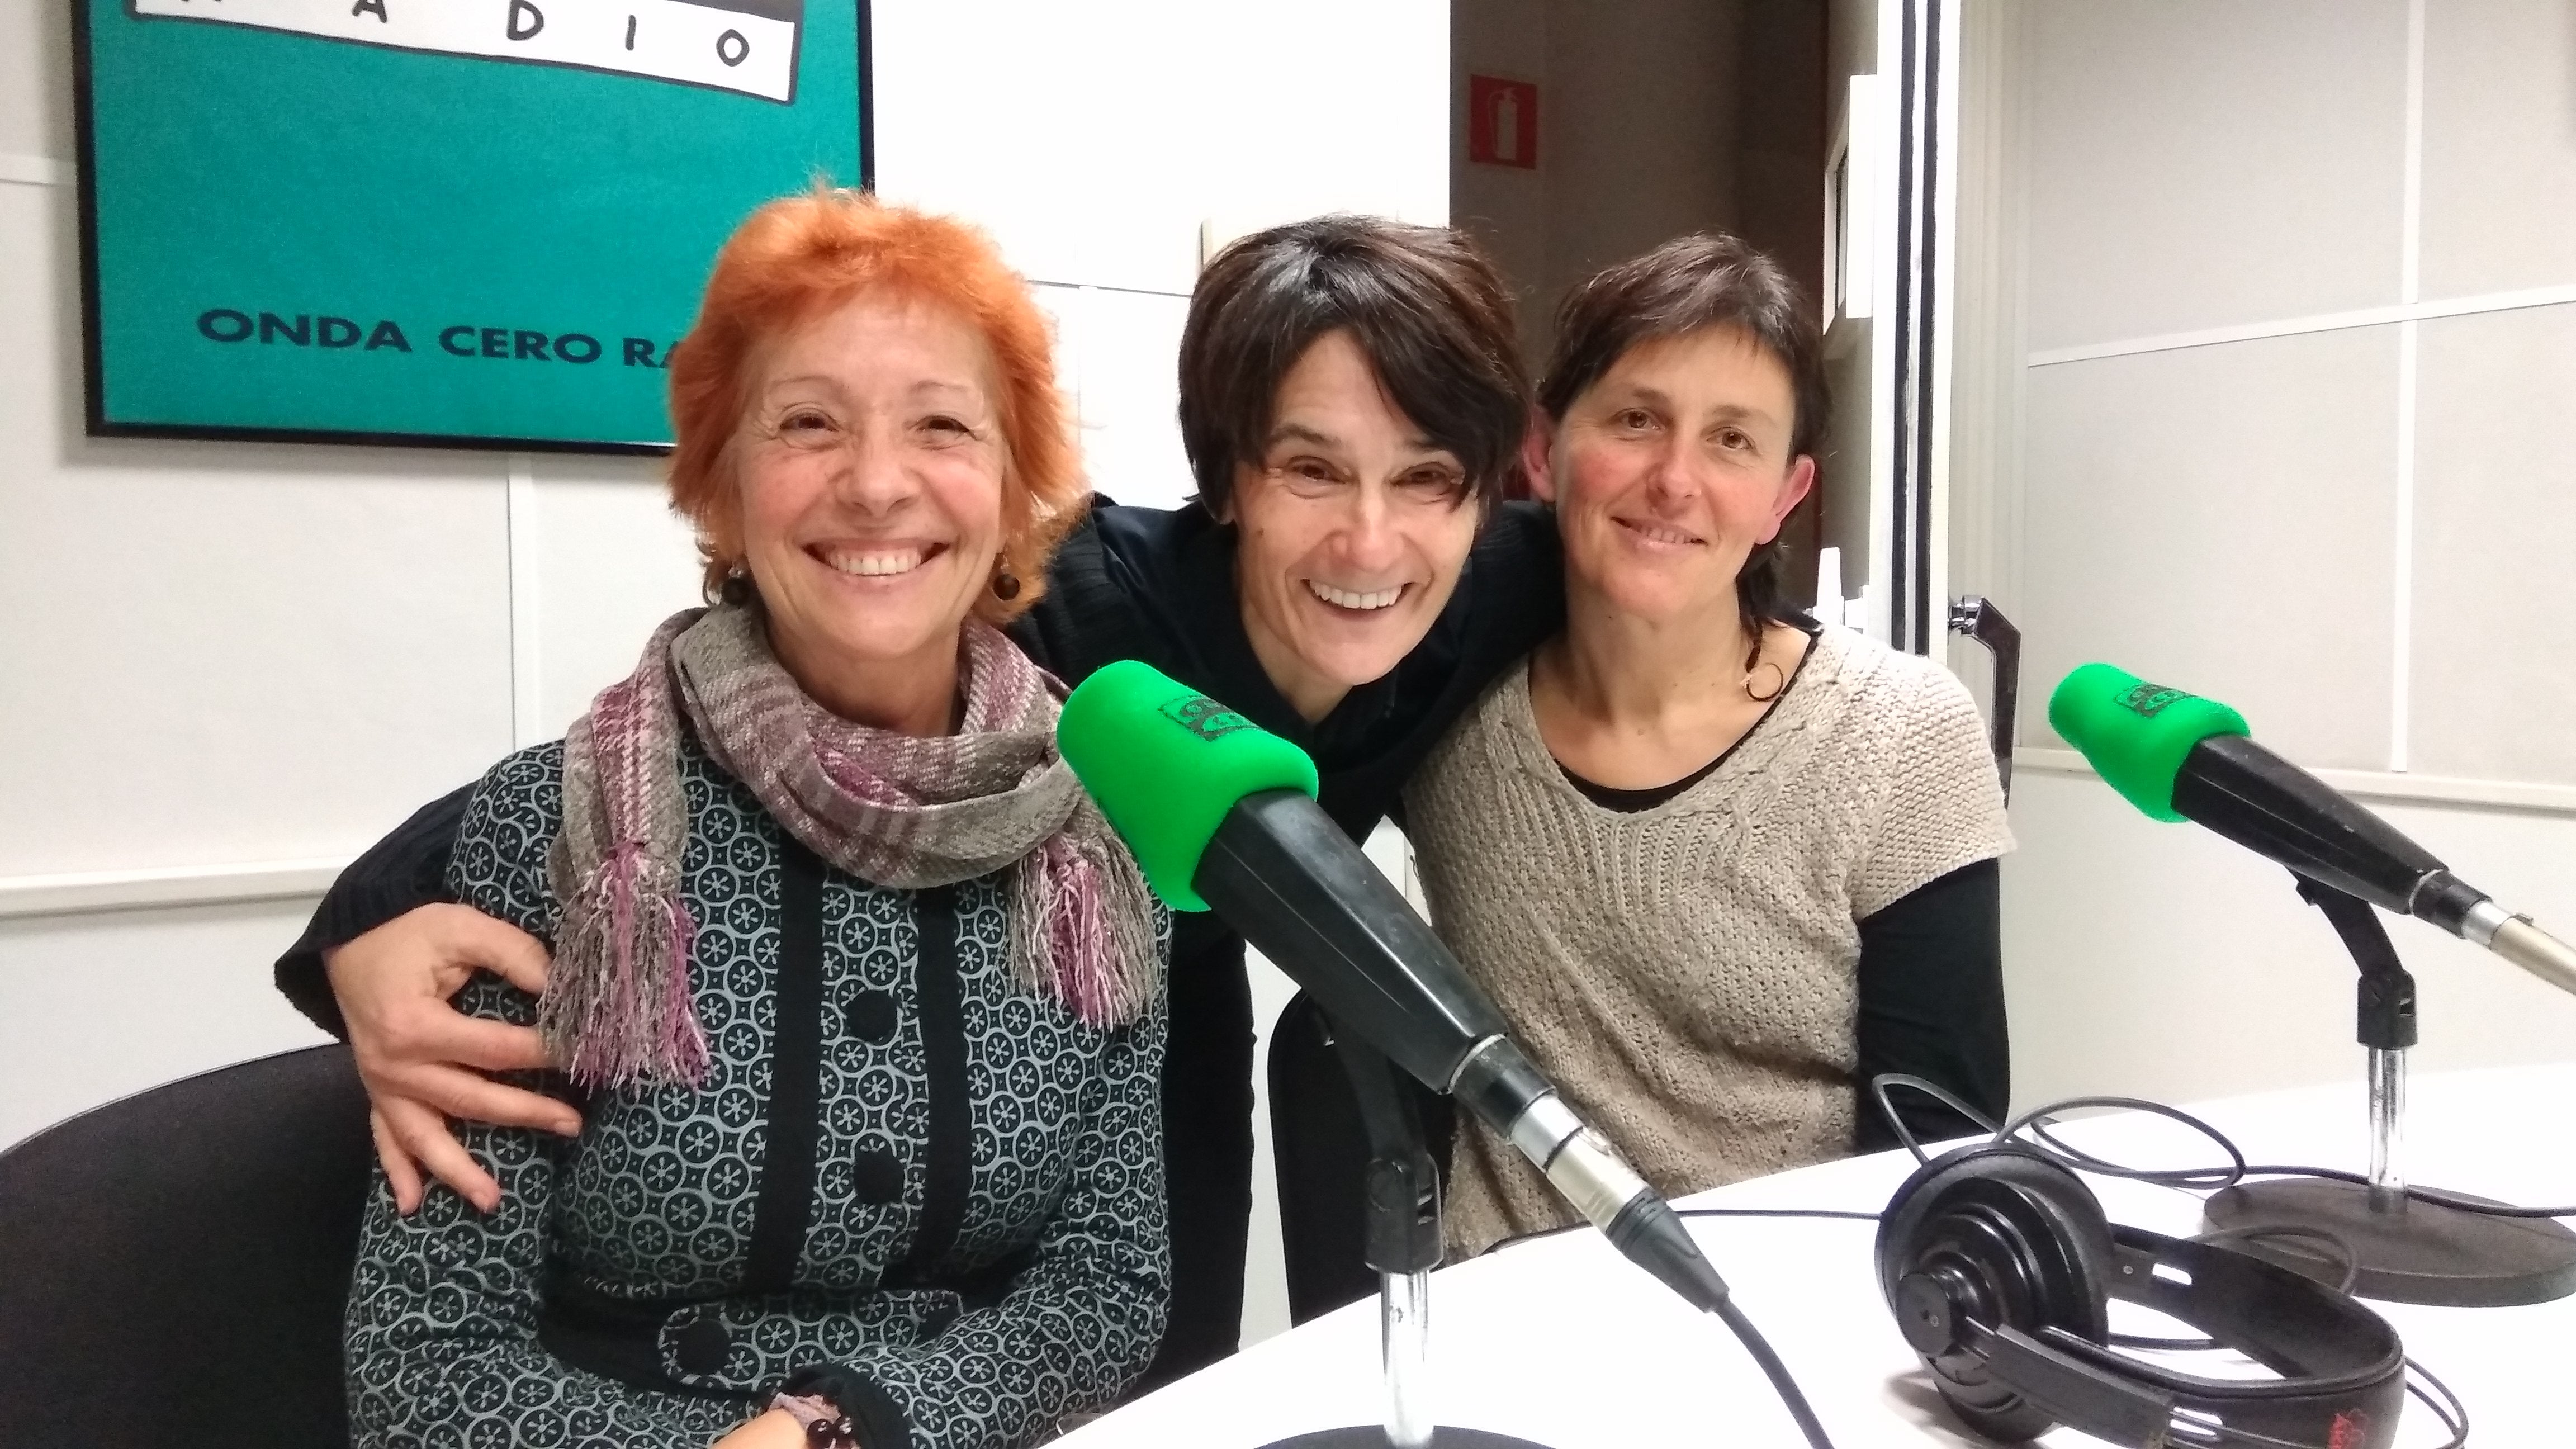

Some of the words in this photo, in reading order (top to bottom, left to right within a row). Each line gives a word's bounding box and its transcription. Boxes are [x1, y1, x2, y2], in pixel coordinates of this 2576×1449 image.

[180, 0, 750, 67] ADIO
[196, 309, 413, 353] ONDA
[438, 325, 602, 364] CERO
